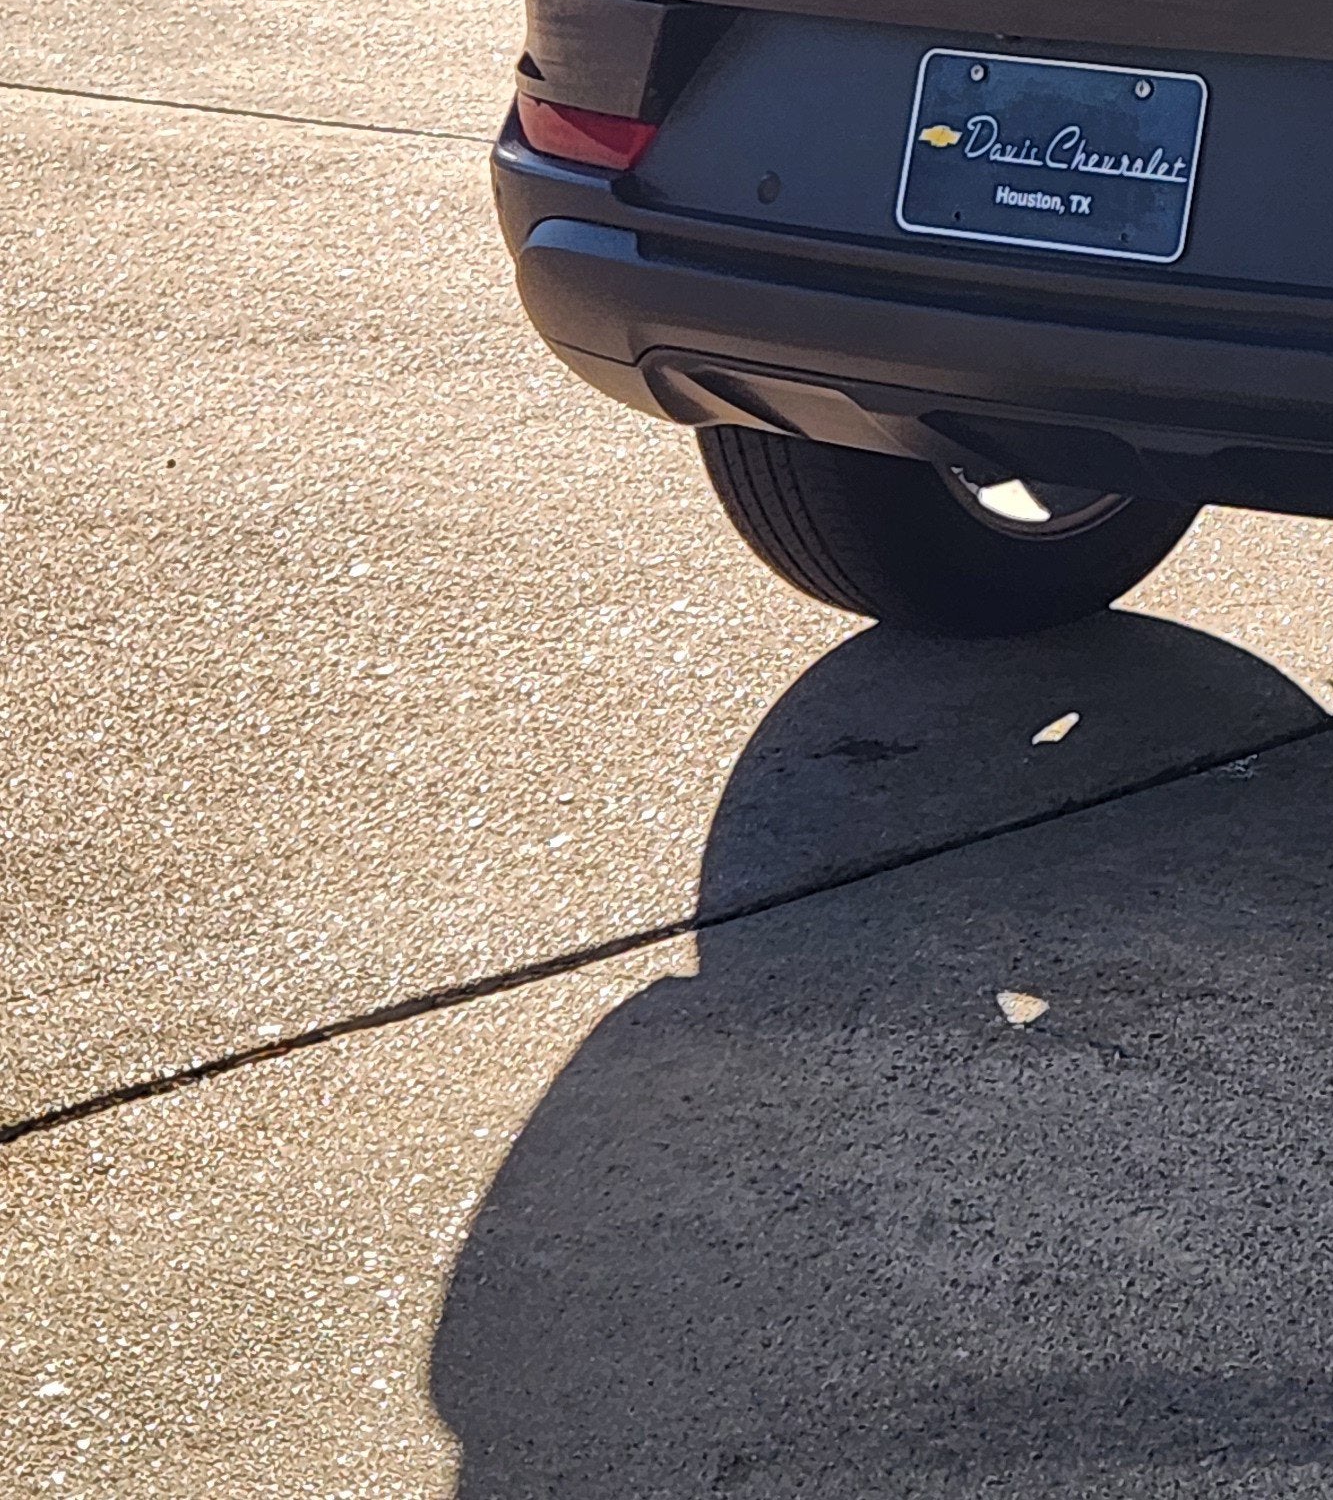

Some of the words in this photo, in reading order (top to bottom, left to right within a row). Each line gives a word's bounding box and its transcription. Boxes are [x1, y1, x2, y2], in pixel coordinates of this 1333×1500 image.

[965, 115, 1043, 166] Davis
[1046, 126, 1188, 182] Chevrolet
[996, 186, 1065, 214] Houston,
[1069, 195, 1091, 213] TX
